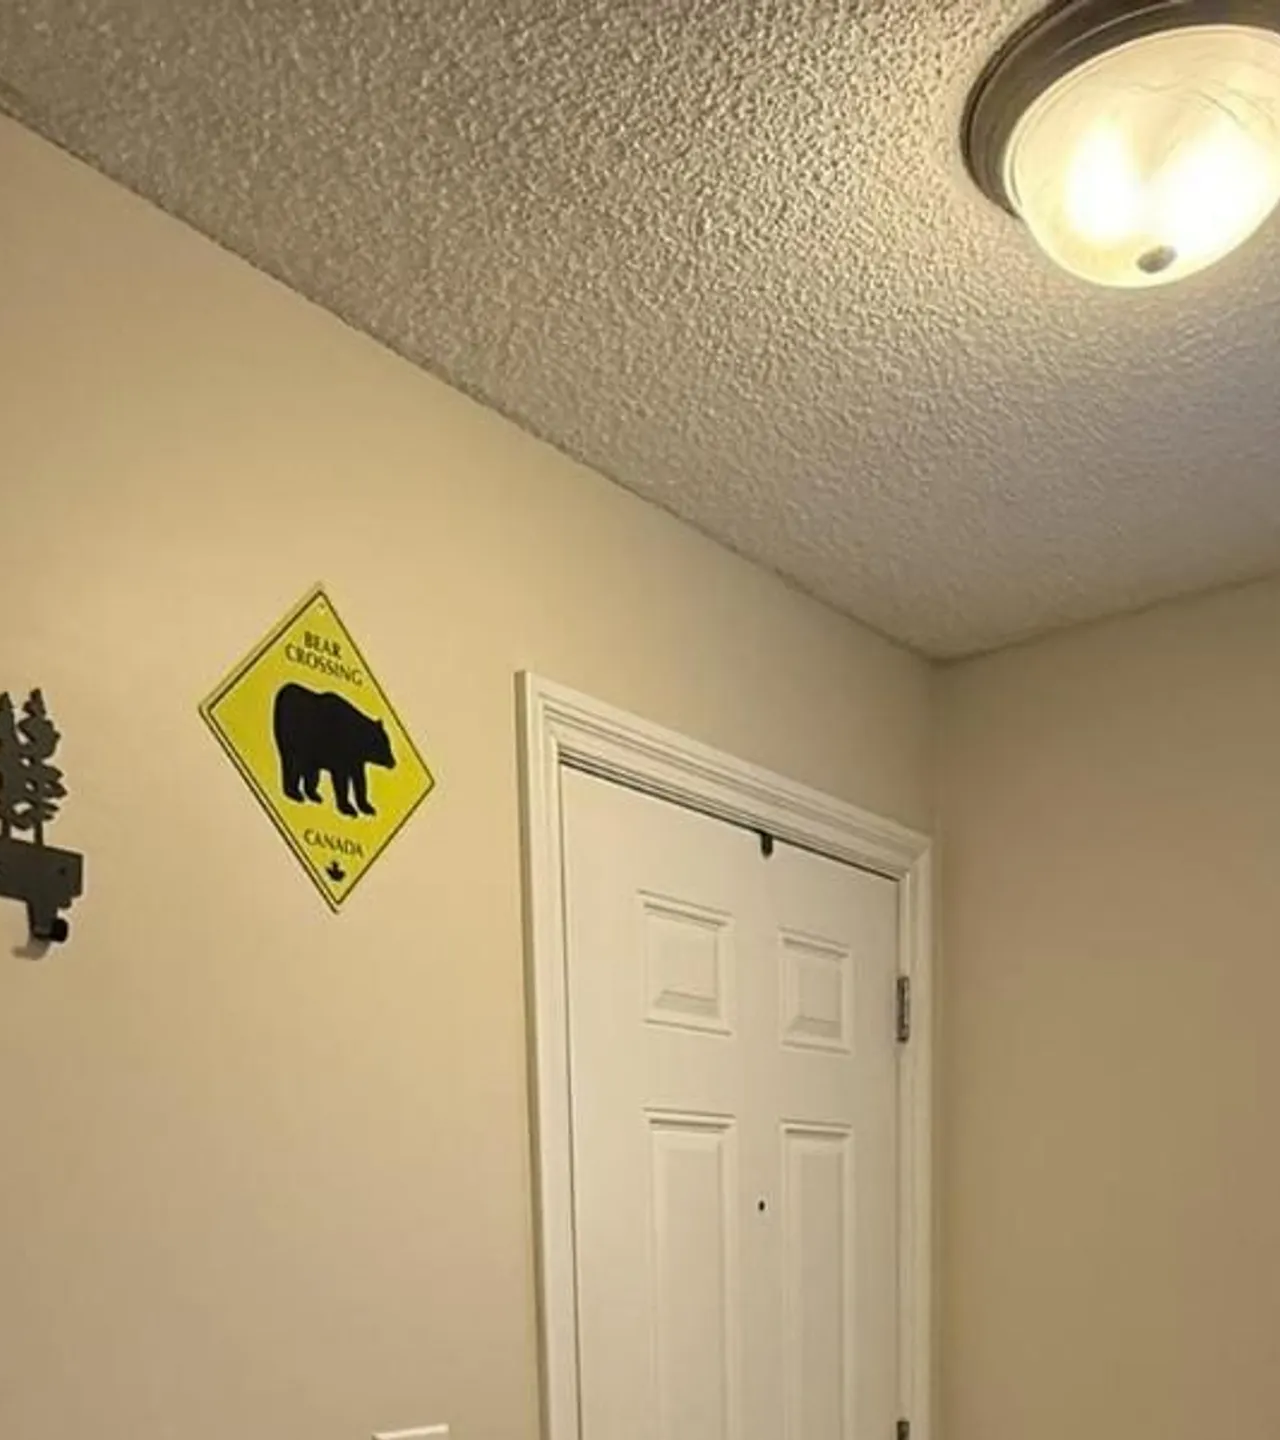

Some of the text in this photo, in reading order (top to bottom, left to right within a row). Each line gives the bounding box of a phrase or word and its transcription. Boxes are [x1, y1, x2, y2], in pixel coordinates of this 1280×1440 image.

[303, 631, 341, 659] BEAR
[285, 643, 363, 686] CROSSING
[303, 829, 364, 857] CANADA
